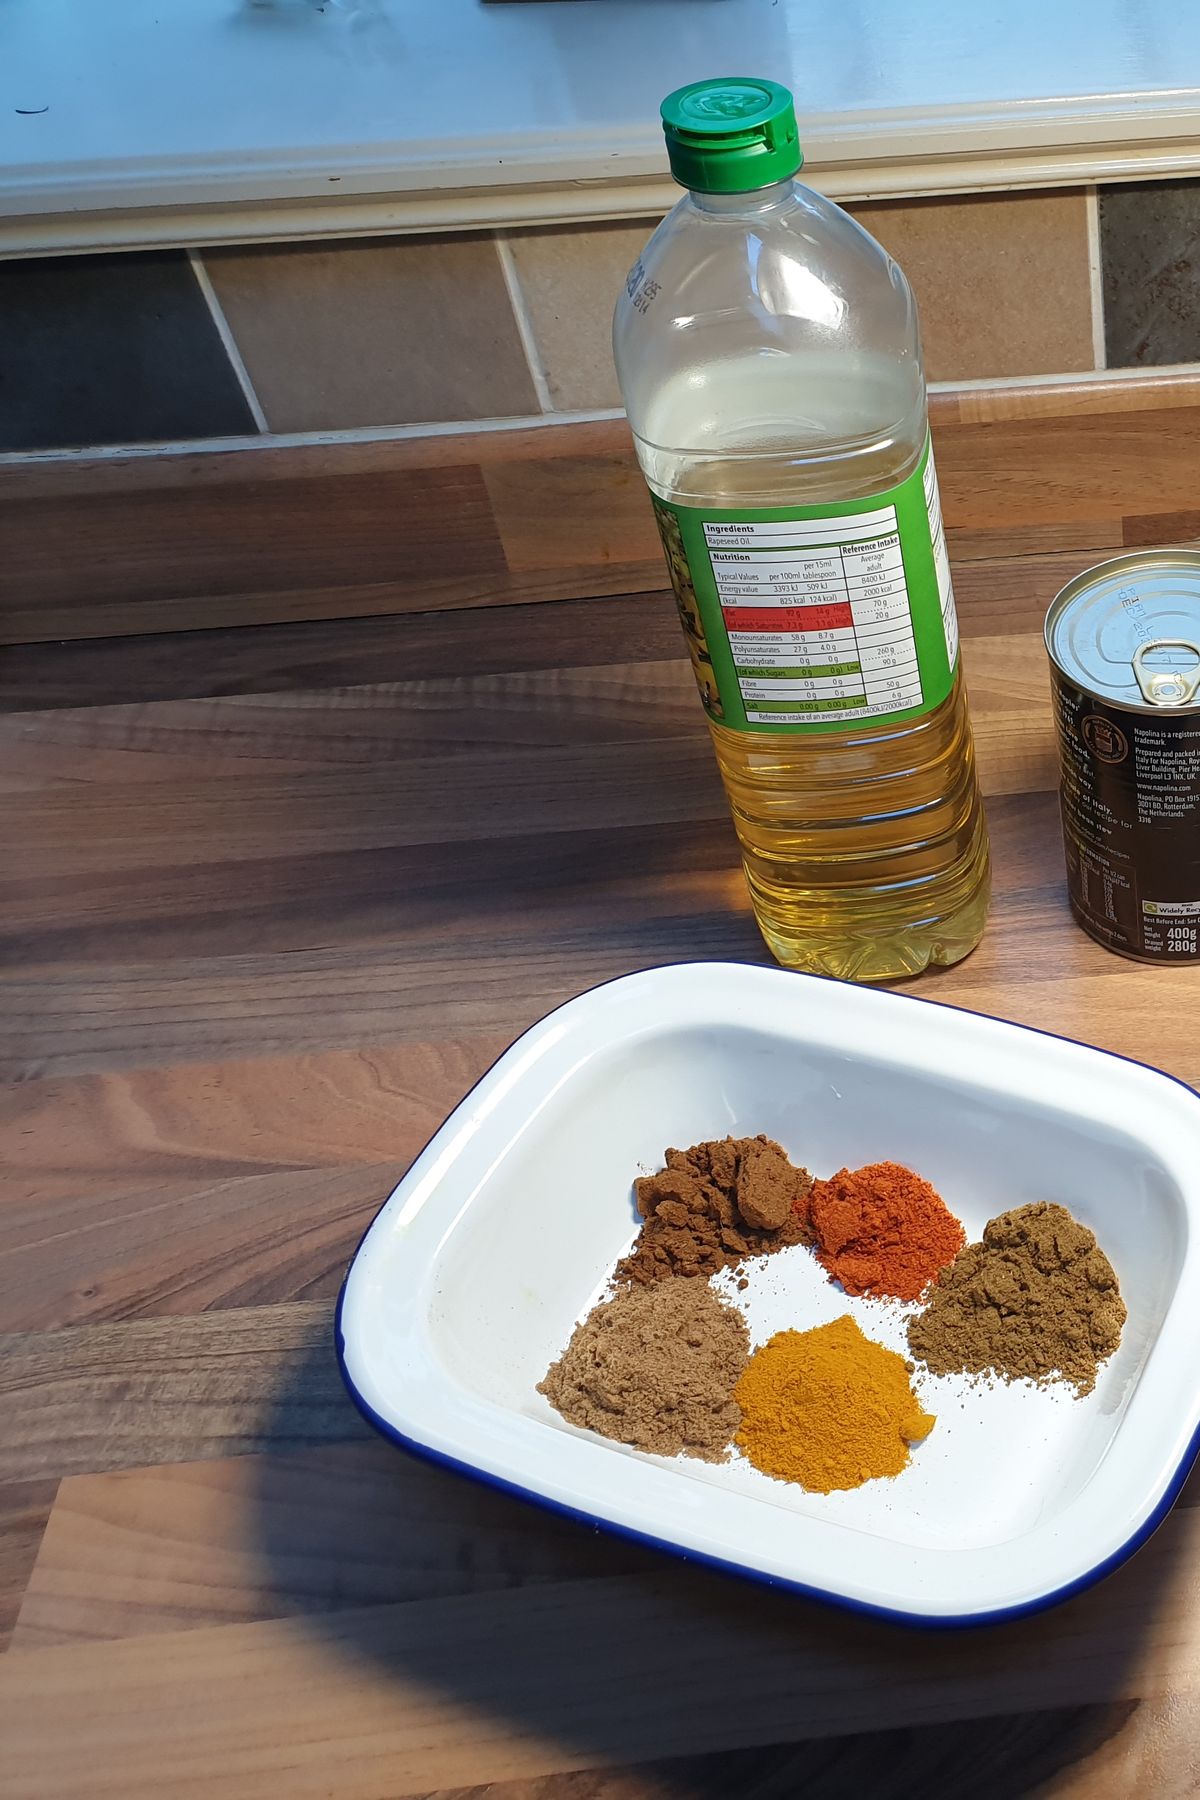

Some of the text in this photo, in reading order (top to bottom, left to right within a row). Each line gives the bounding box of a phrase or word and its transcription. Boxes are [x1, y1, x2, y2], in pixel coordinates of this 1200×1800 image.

[706, 525, 755, 534] Ingredients
[708, 537, 738, 546] Rapeseed
[842, 536, 898, 555] Reference Intake
[713, 553, 751, 561] Nutrition
[861, 552, 885, 563] Average
[804, 560, 832, 570] per 15ml
[867, 563, 883, 572] adult
[717, 572, 738, 581] Typical
[739, 572, 760, 581] Values
[802, 571, 837, 581] tablespoon
[861, 575, 878, 584] 8400
[720, 585, 740, 594] Energy
[791, 584, 799, 592] kJ
[807, 583, 819, 591] 509
[863, 584, 893, 597] 2000 kcal
[780, 597, 793, 605] 825
[793, 596, 806, 605] kcal
[809, 596, 822, 604] 124
[731, 634, 783, 642] Monounsaturates
[734, 646, 780, 654] Polyunsaturates
[877, 647, 890, 655] 260
[736, 657, 775, 665] Carbohydrate
[765, 669, 786, 677] Sugars
[847, 664, 859, 672] Low
[744, 691, 766, 699] Protein
[758, 713, 787, 721] Reference
[821, 711, 844, 721] average
[844, 709, 859, 718] adult
[1134, 728, 1160, 738] Napolina
[1135, 747, 1161, 757] Prepared
[1162, 749, 1174, 757] and
[1174, 749, 1195, 759] packed
[1135, 756, 1149, 765] Italy
[1150, 757, 1159, 765] for
[1135, 763, 1150, 771] Liver
[1178, 765, 1190, 773] Pier
[1136, 770, 1163, 780] Liverpool
[1136, 783, 1191, 792] www.napolina.com
[1164, 795, 1173, 803] PO
[1174, 795, 1185, 803] Box
[1092, 799, 1113, 815] Italy.
[1137, 800, 1151, 808] 3001
[1138, 807, 1148, 815] The
[1138, 816, 1152, 824] 3316
[1143, 916, 1155, 924] Best
[1167, 927, 1197, 940] 400g
[1144, 939, 1163, 947] Drained
[1167, 940, 1197, 953] 280g
